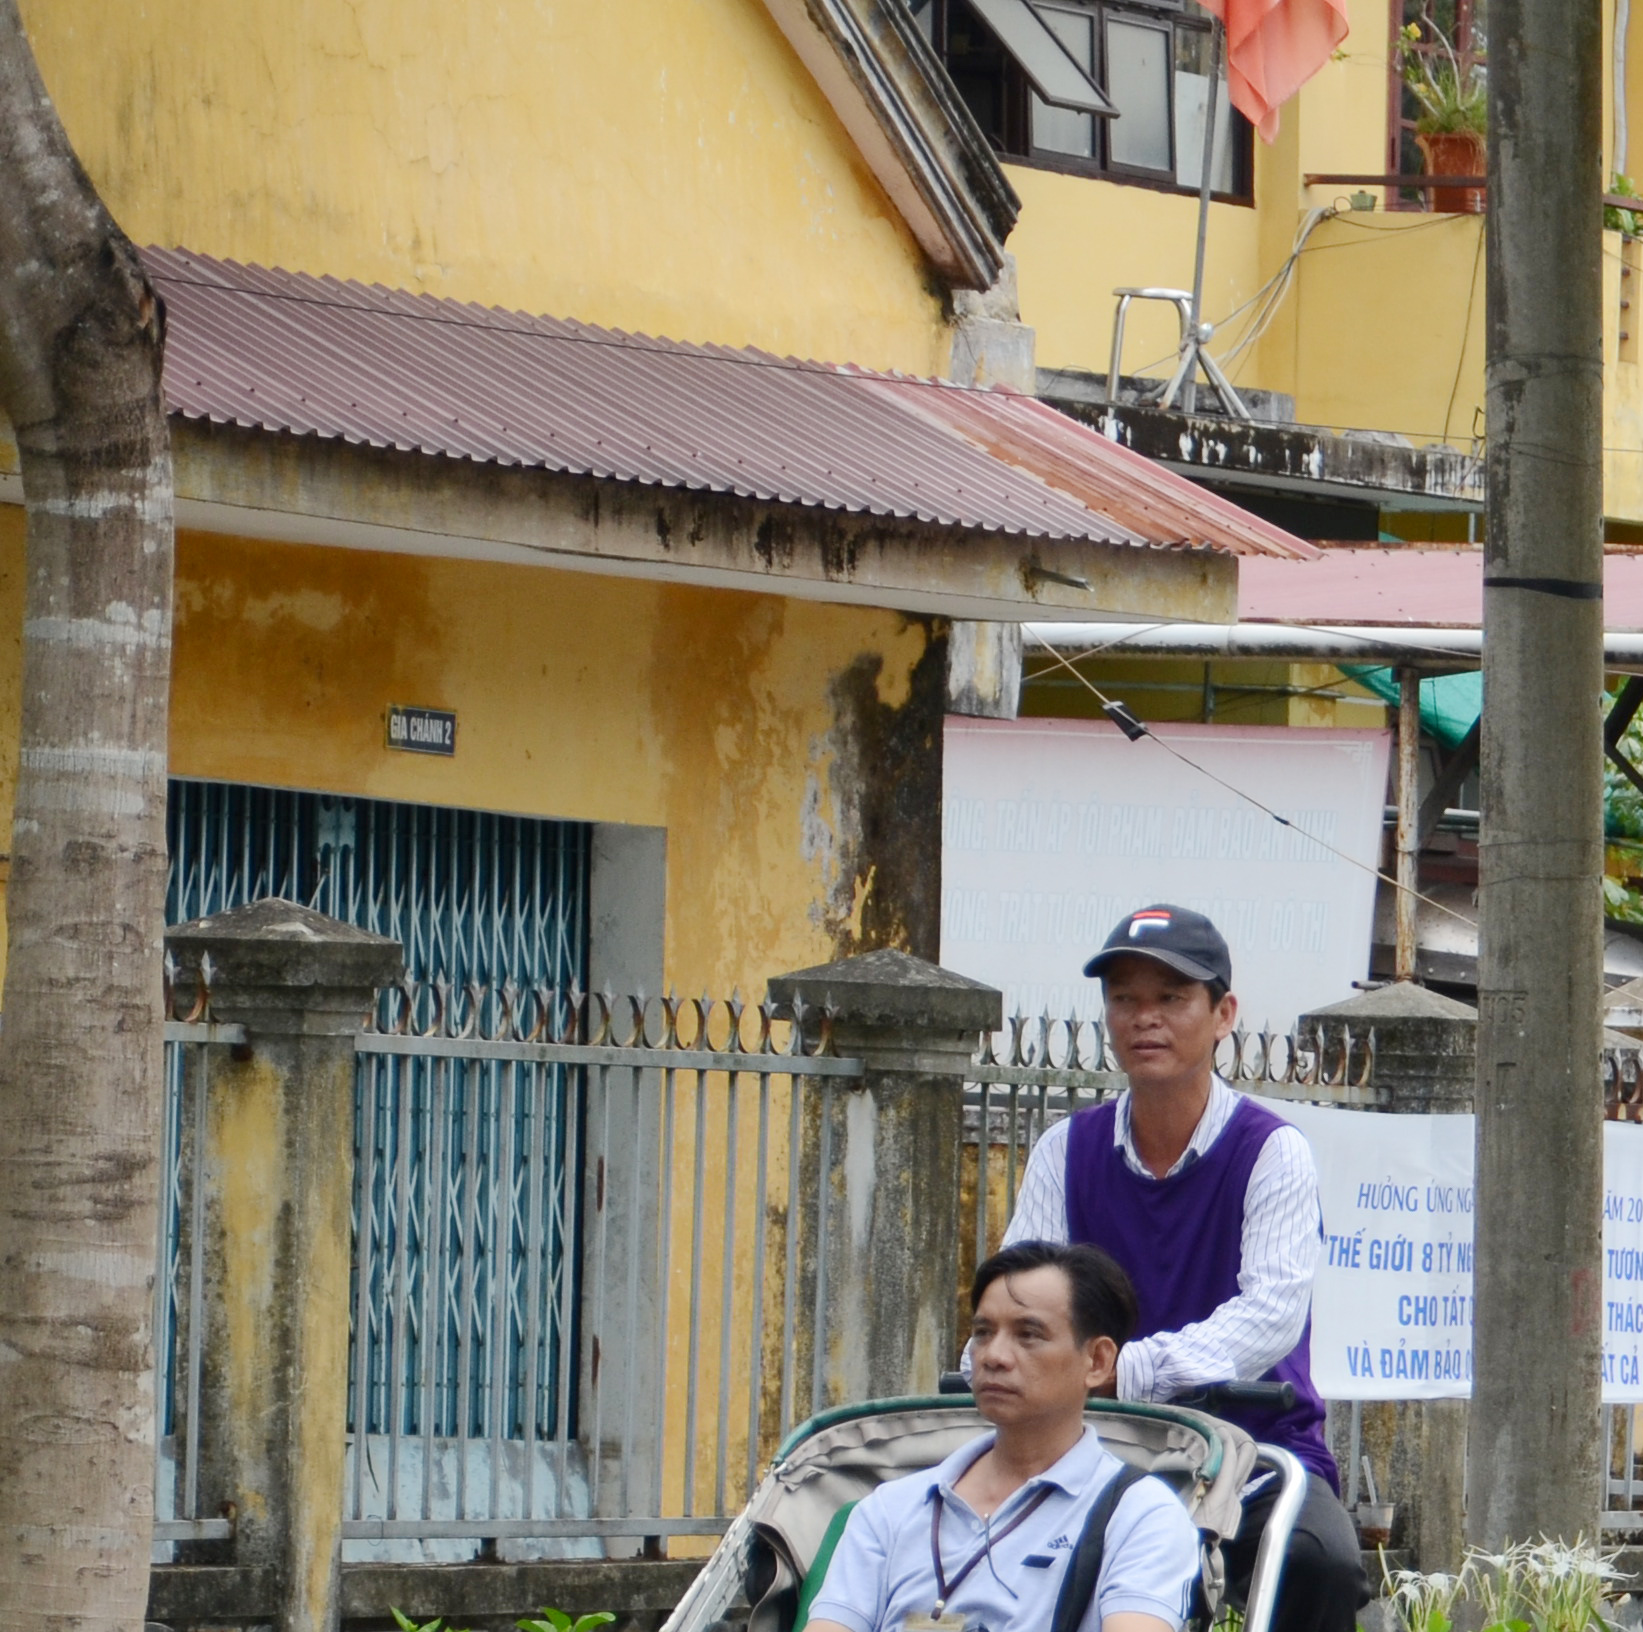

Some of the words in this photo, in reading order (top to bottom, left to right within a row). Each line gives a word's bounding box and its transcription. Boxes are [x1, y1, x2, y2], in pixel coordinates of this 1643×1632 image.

[391, 714, 408, 740] GIA
[410, 712, 443, 744] CHÁNH
[445, 721, 452, 745] 2
[1357, 1175, 1418, 1212] HƯỞNG
[1426, 1178, 1453, 1213] ỨNG
[1369, 1234, 1413, 1272] GIỚI
[1421, 1242, 1433, 1272] 8
[1398, 1295, 1438, 1327] CHO
[1442, 1284, 1466, 1327] TẤT
[1607, 1296, 1643, 1333] THÁC
[1347, 1340, 1374, 1378] VÀ
[1380, 1338, 1429, 1380] ĐẢM
[1434, 1339, 1461, 1380] BẢO
[1620, 1345, 1640, 1385] CẢ
